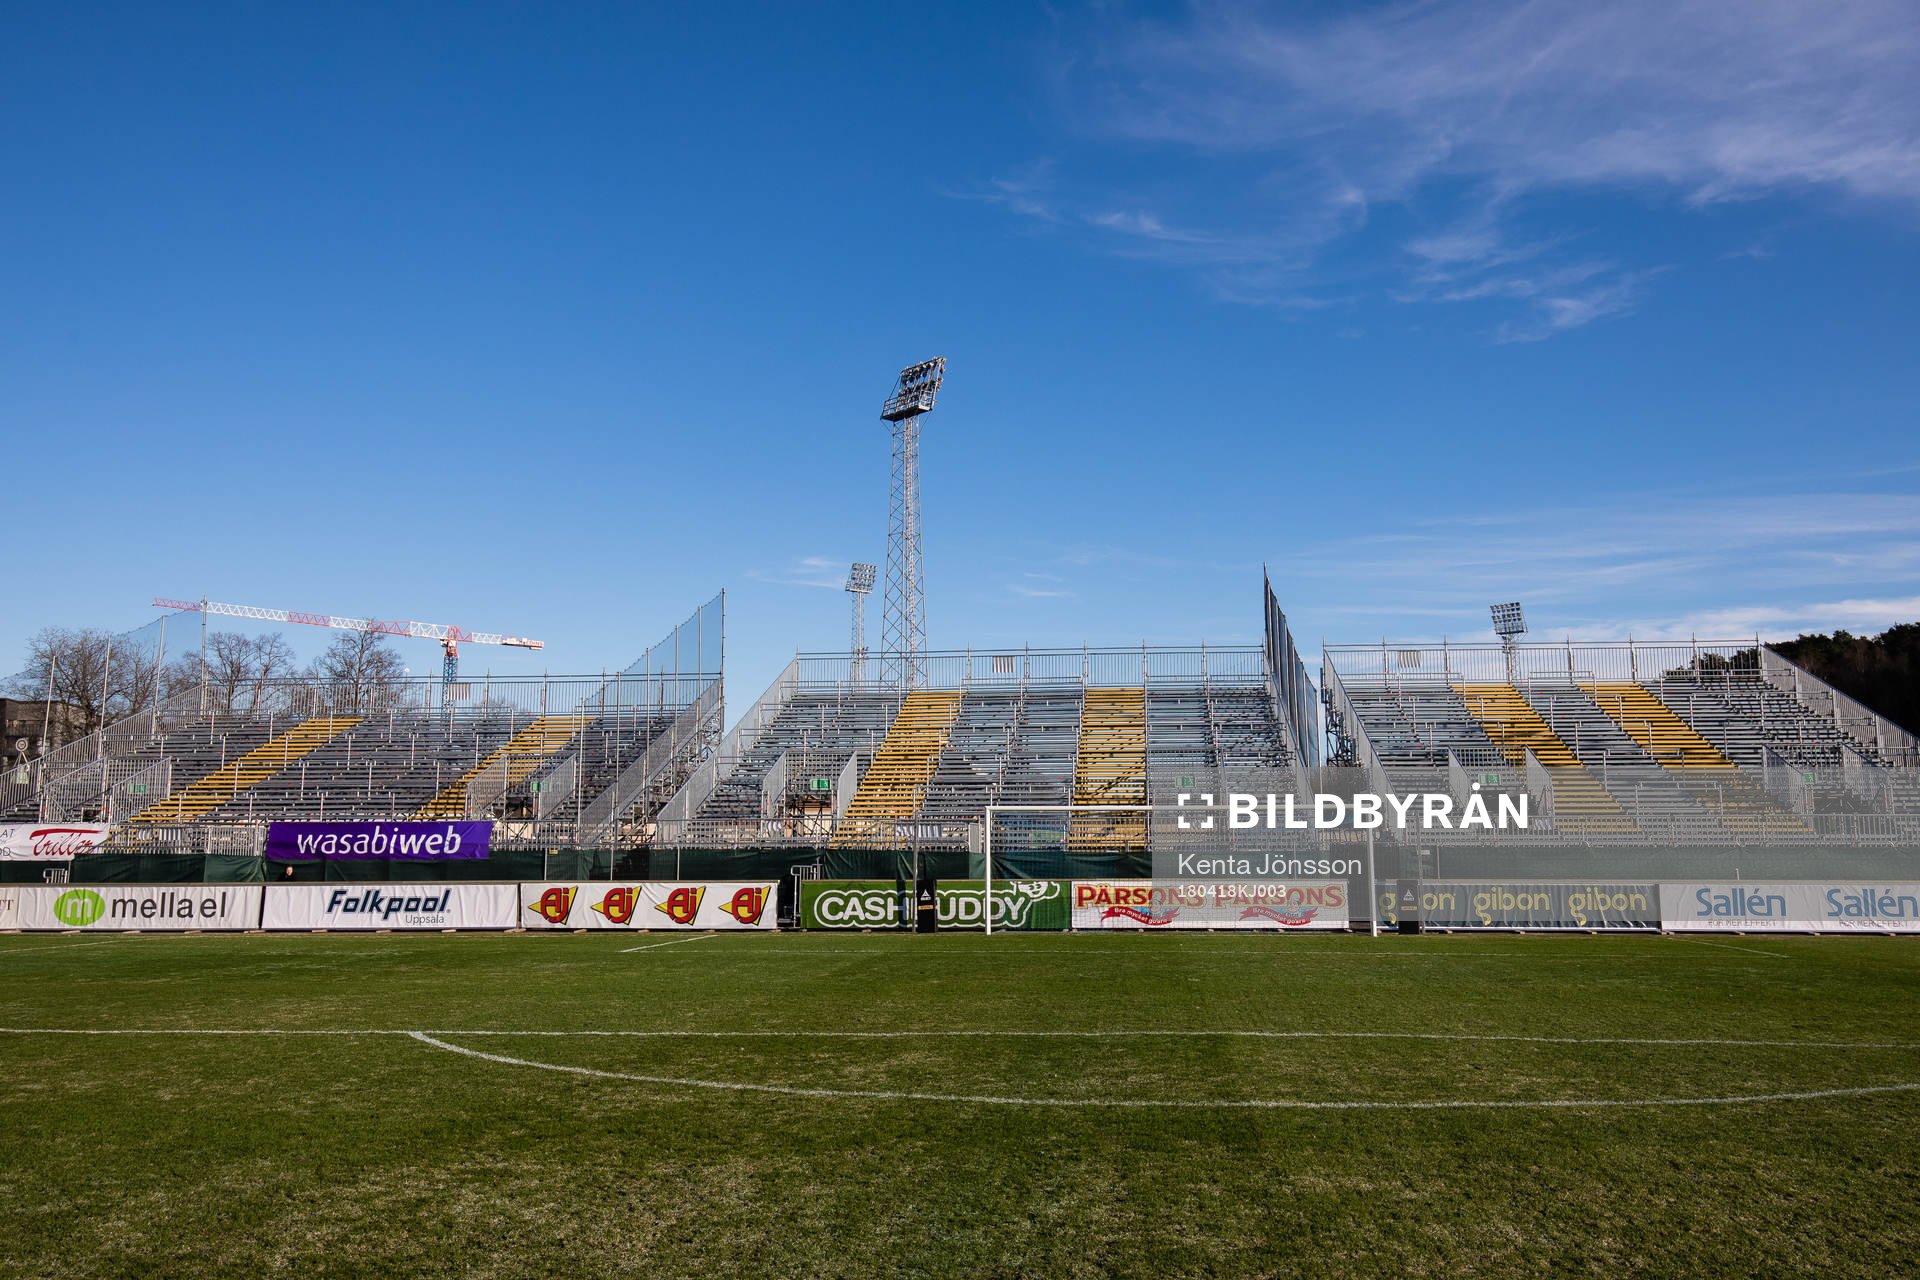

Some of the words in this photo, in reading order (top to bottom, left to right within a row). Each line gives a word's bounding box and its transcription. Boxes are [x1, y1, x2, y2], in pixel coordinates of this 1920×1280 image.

[297, 825, 462, 855] wasabiweb
[326, 888, 452, 920] Folkpool
[821, 896, 1026, 921] CASHUDDY
[1075, 884, 1206, 908] PÄRSONS
[1379, 891, 1456, 925] gon
[1473, 887, 1551, 926] gibon
[1568, 887, 1648, 926] gibon
[1696, 887, 1787, 917] Sallén
[1826, 888, 1920, 918] Sallén
[405, 913, 445, 926] Uppsala
